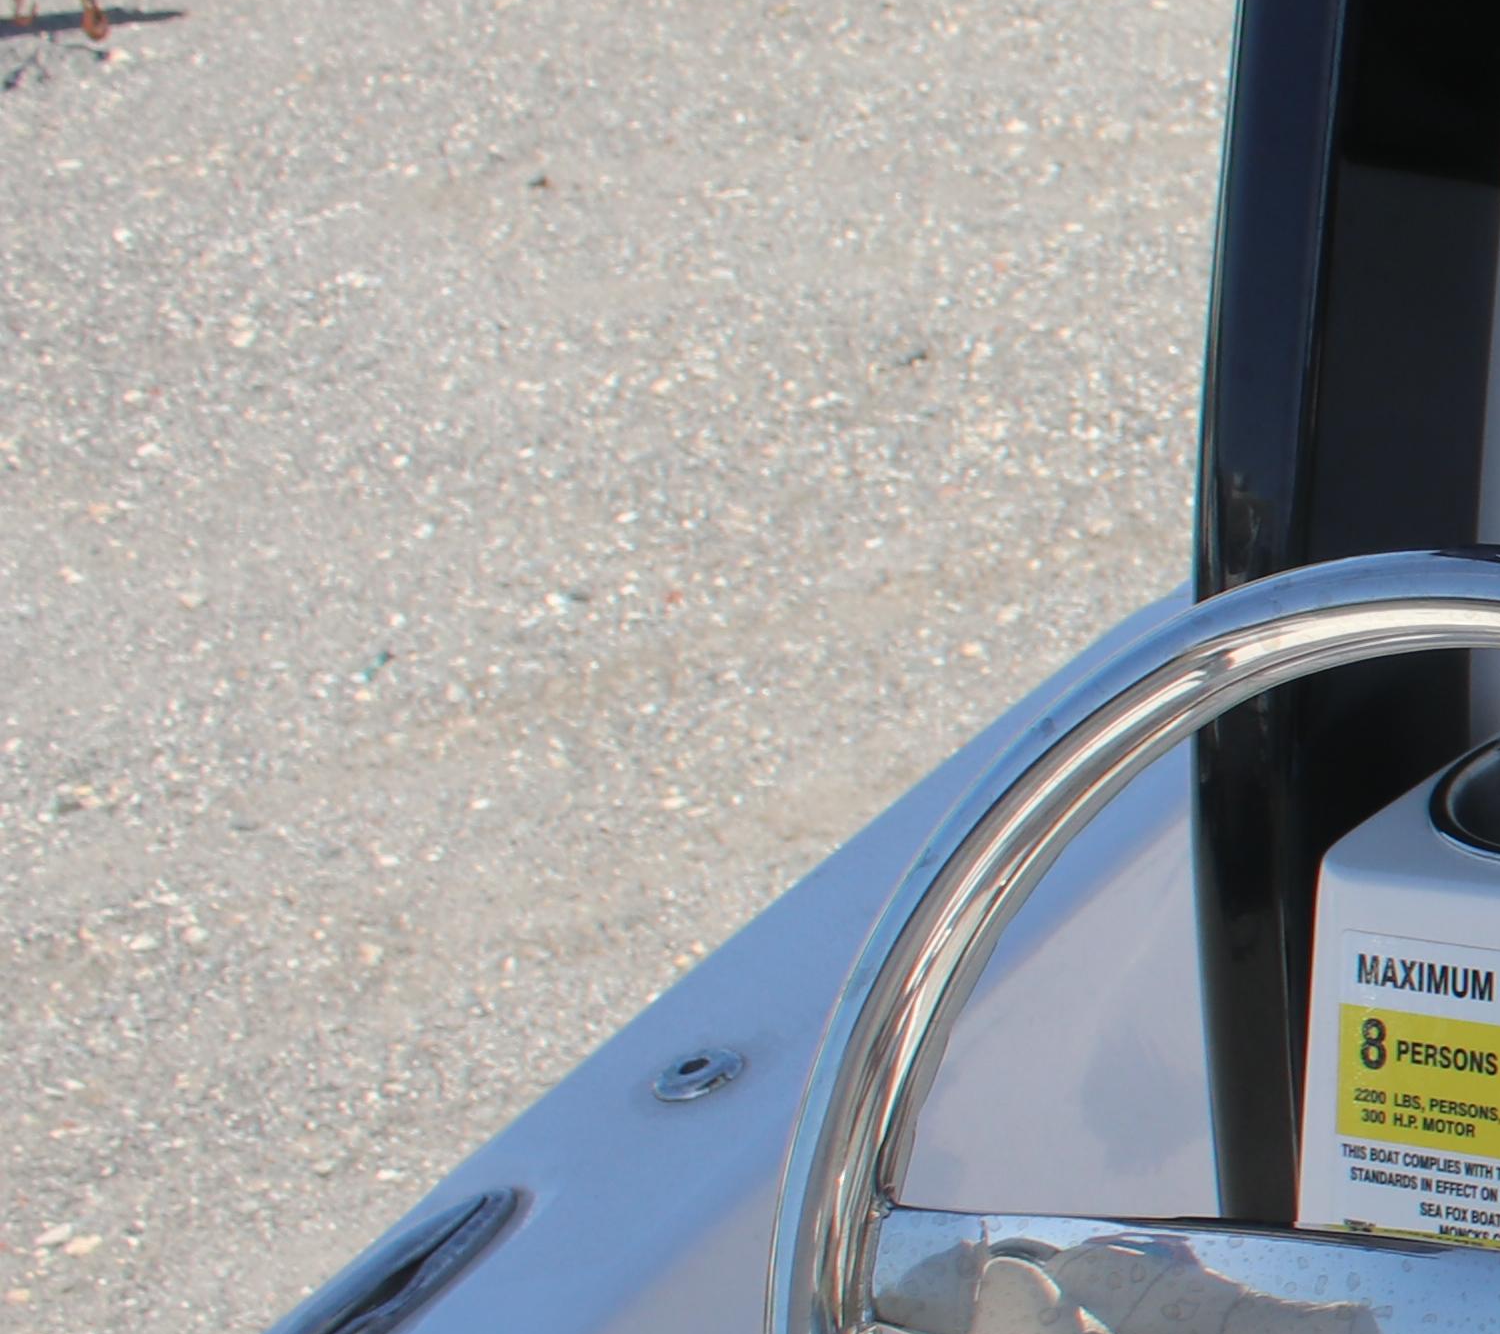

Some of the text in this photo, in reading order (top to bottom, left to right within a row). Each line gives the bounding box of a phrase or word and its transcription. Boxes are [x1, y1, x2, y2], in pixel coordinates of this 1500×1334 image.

[1357, 953, 1494, 1001] MAXIMUM
[1360, 1018, 1387, 1070] 8
[1396, 1040, 1498, 1076] PERSONS
[1354, 1088, 1387, 1105] 2200
[1394, 1093, 1425, 1113] LBS,
[1361, 1108, 1476, 1138] 300 H.P. MOTOR
[1341, 1143, 1367, 1160] THIS
[1369, 1147, 1400, 1165] BOAT
[1402, 1152, 1461, 1175] COMPLIES
[1464, 1162, 1493, 1180] WITH
[1350, 1166, 1418, 1190] STANDARDS
[1420, 1177, 1433, 1192] IN
[1435, 1179, 1478, 1199] EFFECT
[1480, 1186, 1498, 1202] ON
[1420, 1202, 1443, 1218] SEA
[1445, 1206, 1468, 1222] FOX
